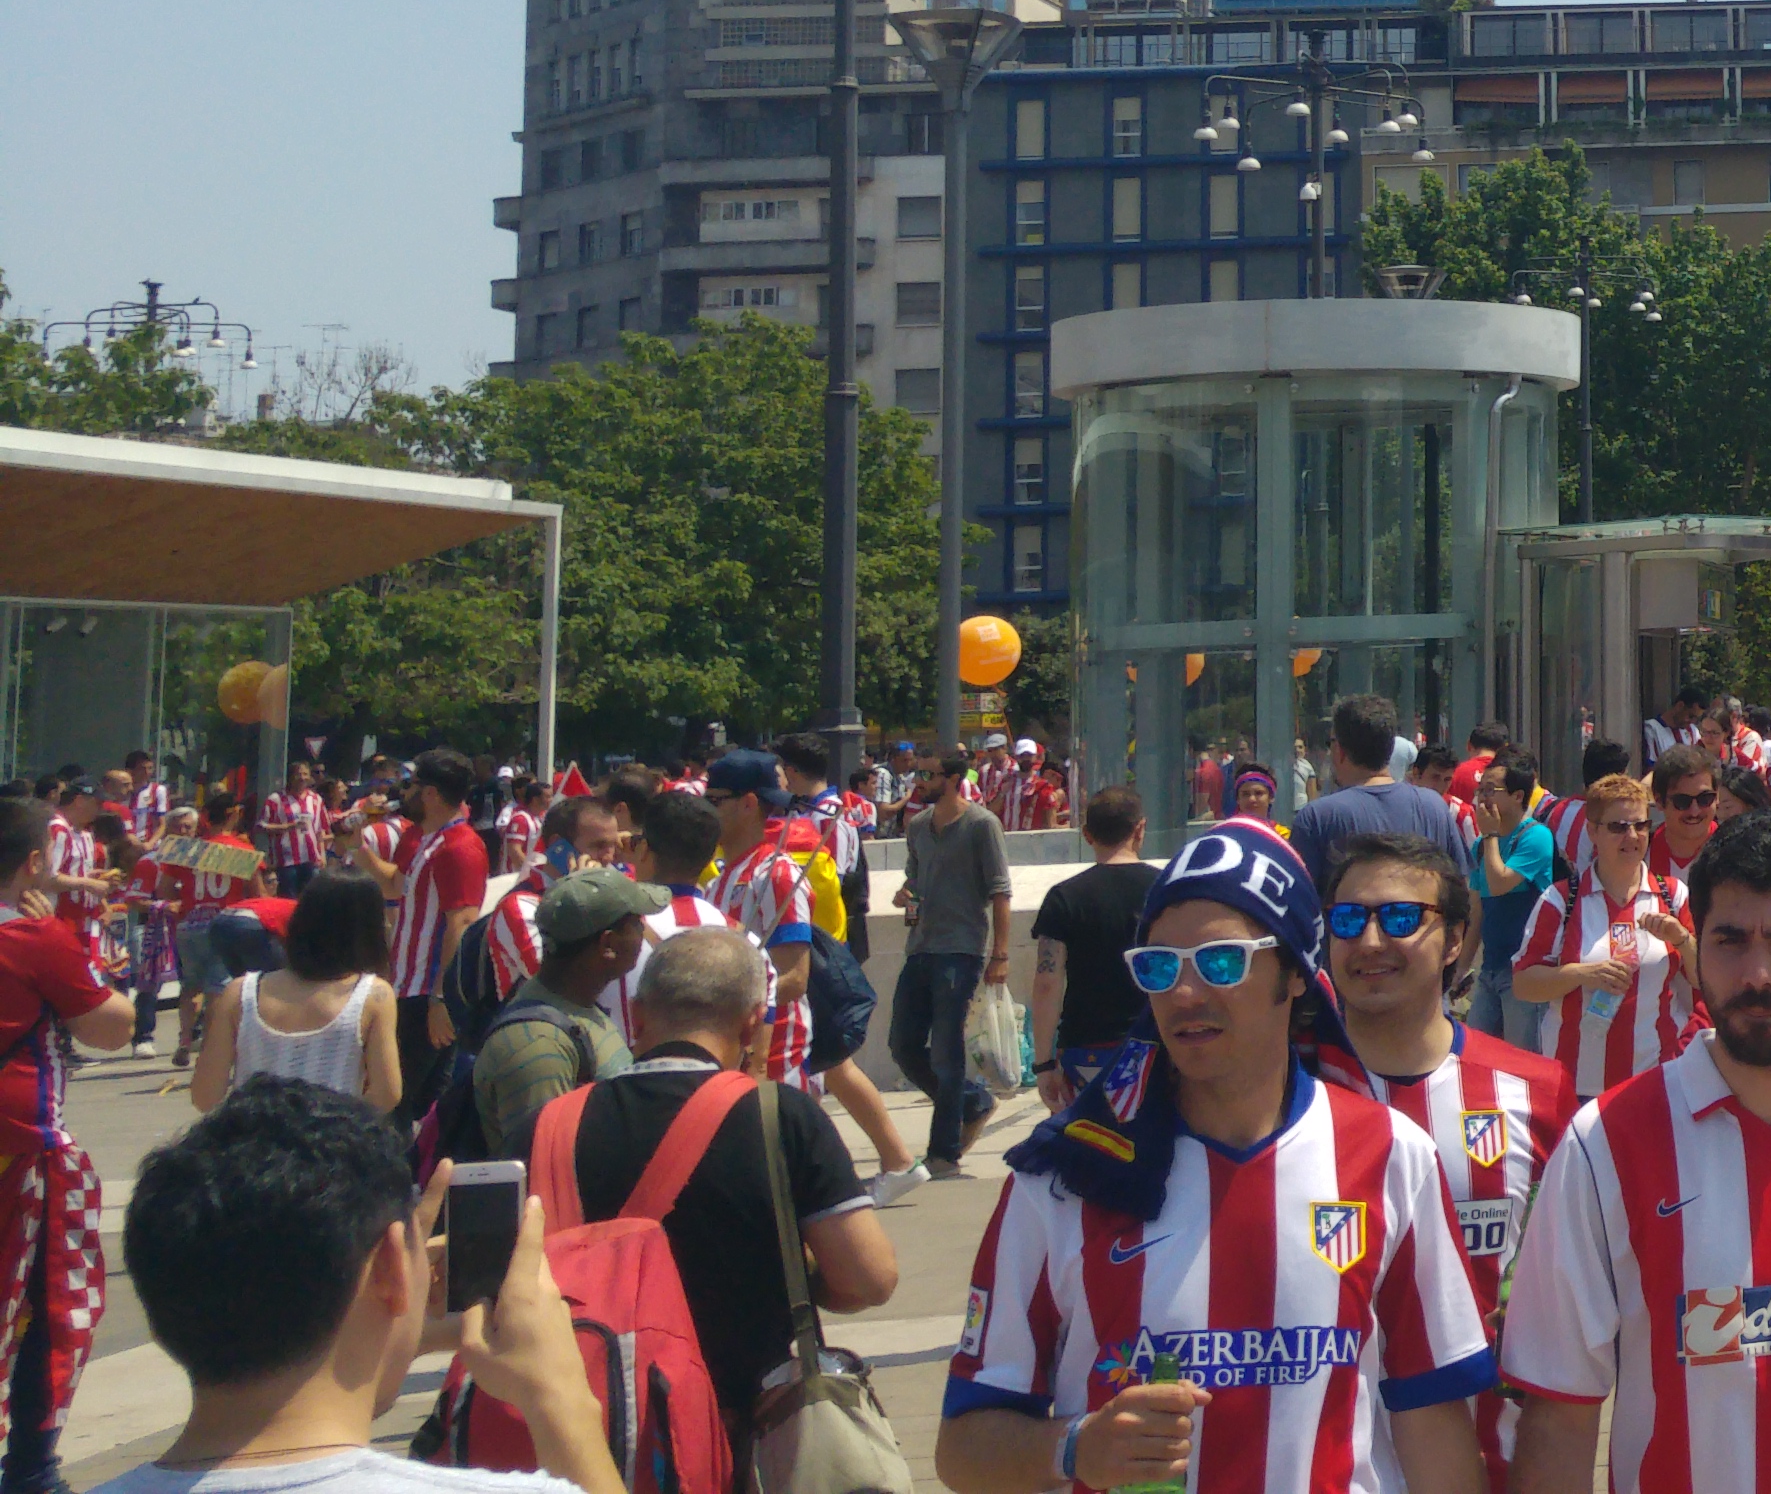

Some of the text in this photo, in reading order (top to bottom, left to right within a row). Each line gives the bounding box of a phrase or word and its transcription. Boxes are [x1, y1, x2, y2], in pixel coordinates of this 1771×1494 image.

[1165, 835, 1295, 918] DE
[1471, 1208, 1508, 1220] Online
[1128, 1325, 1362, 1377] AZERBAIJAN
[1215, 1367, 1245, 1387] OF
[1256, 1364, 1306, 1385] FIRE
